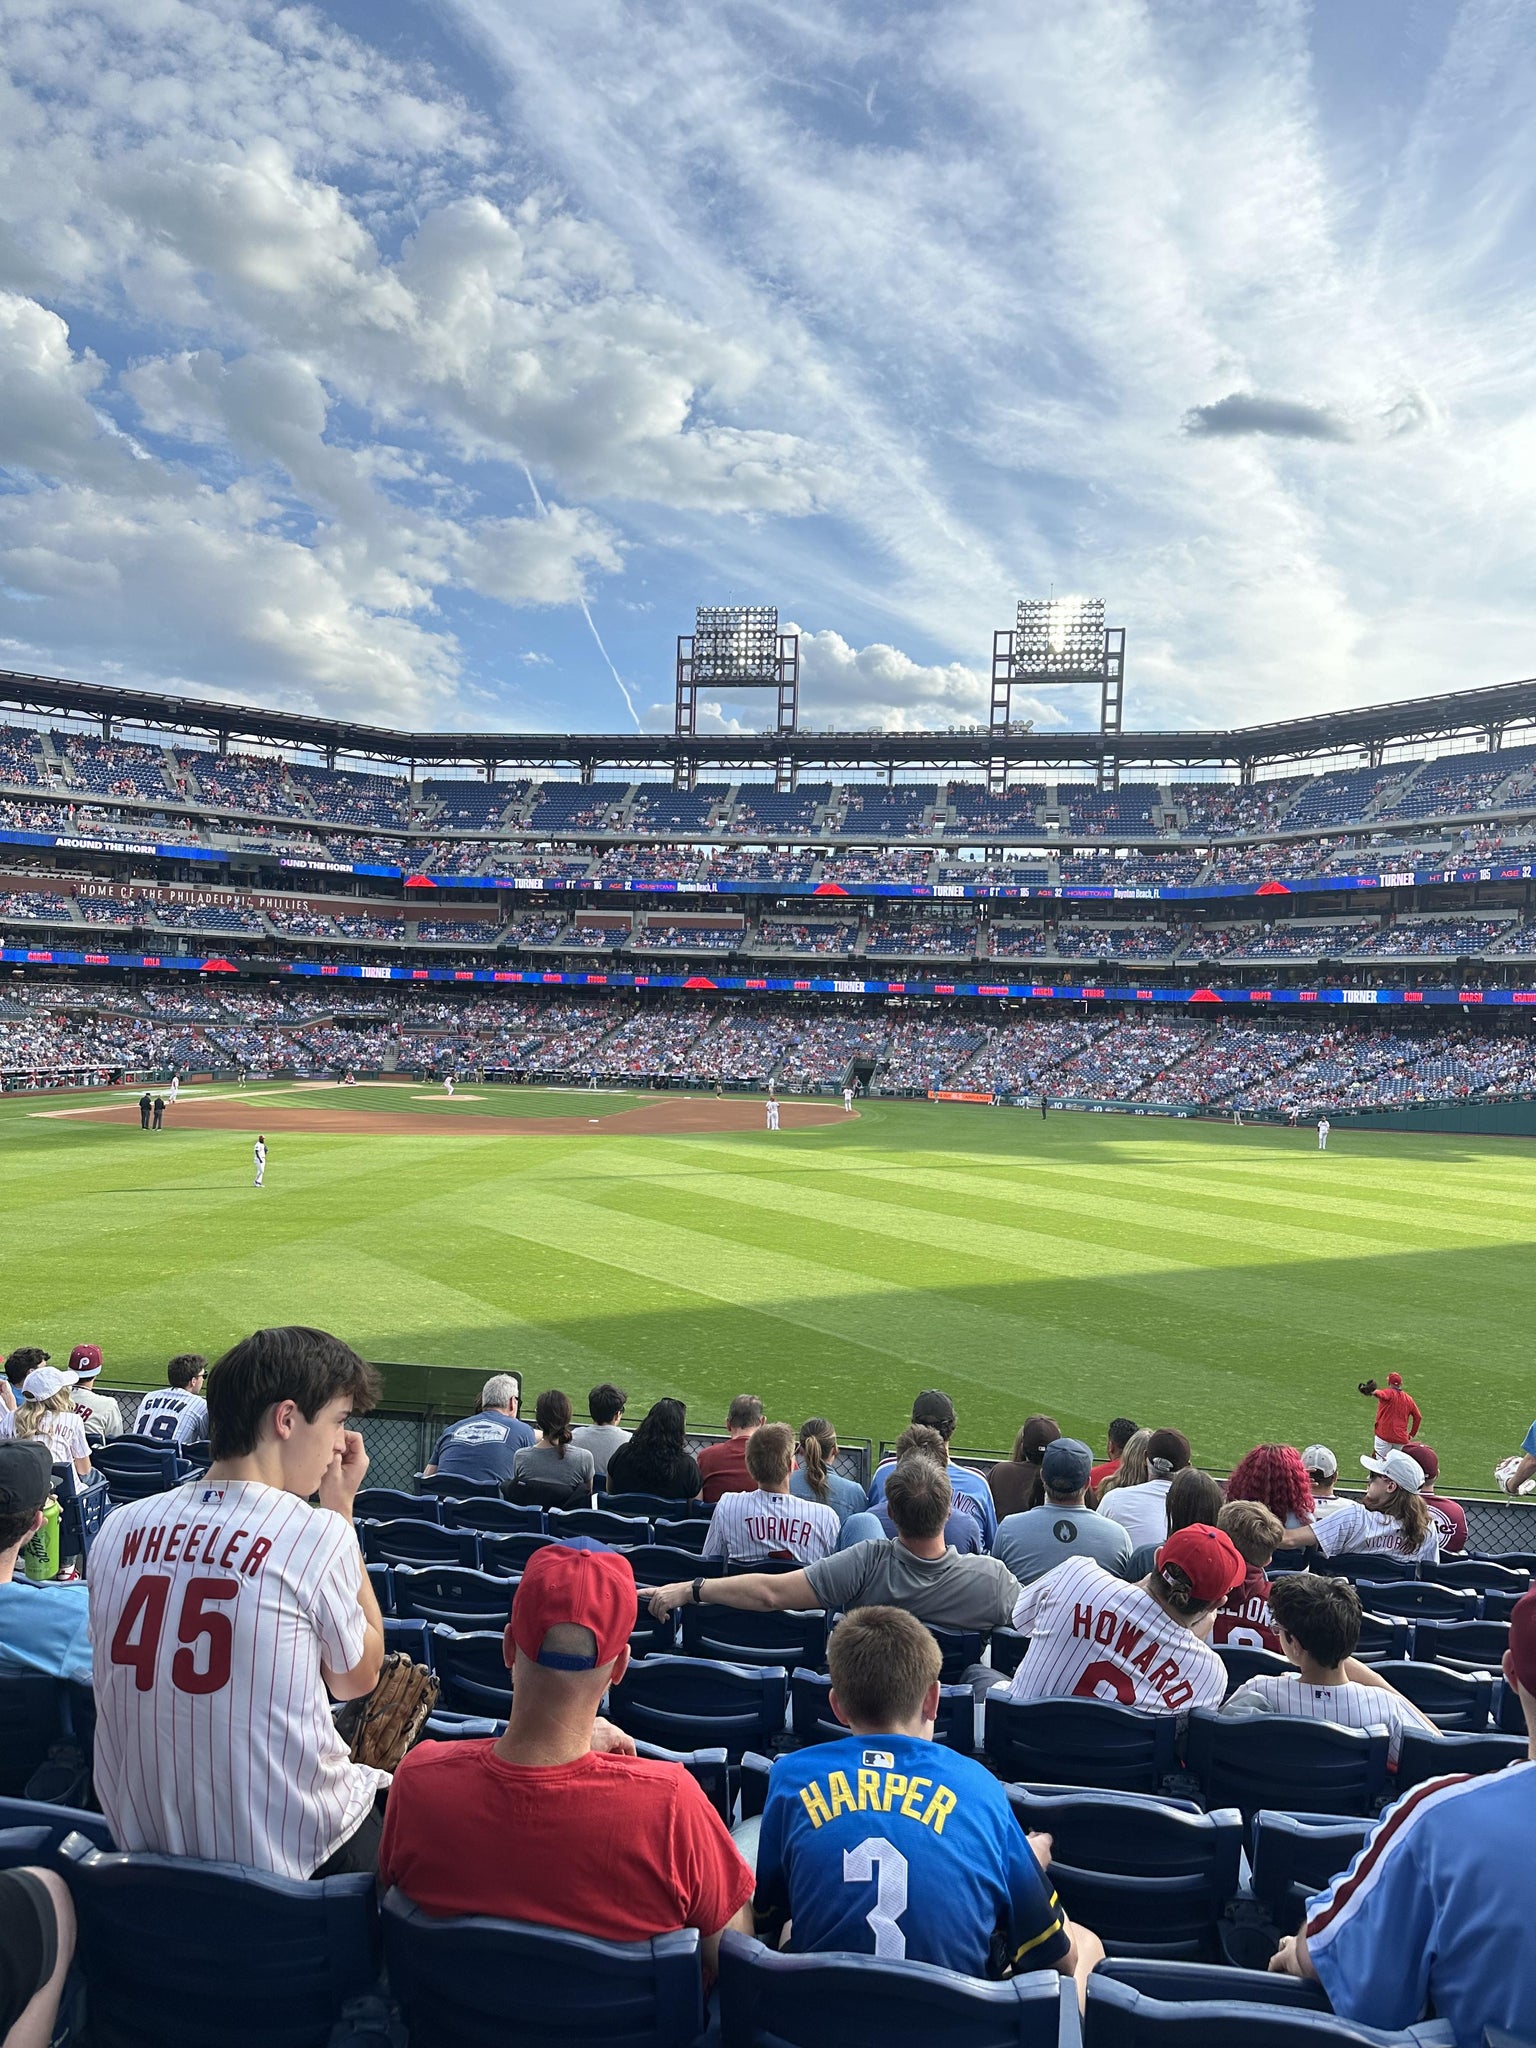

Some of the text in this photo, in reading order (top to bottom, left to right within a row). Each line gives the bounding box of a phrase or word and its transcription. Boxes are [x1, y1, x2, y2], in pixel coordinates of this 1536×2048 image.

[55, 838, 156, 854] AROUND THE HORN
[280, 859, 353, 872] OUND THE HORN
[514, 879, 543, 889] TURNER
[625, 881, 632, 890] 32
[1380, 873, 1415, 887] TURNER
[1479, 869, 1491, 880] 185
[1522, 866, 1531, 877] 32
[80, 884, 114, 897] HOME
[142, 888, 163, 899] THE
[259, 897, 309, 910] PHILLIES
[933, 886, 964, 897] TURNER
[1055, 888, 1062, 897] 32
[1154, 890, 1160, 898] FL
[361, 966, 391, 978] TURNER
[834, 981, 865, 992] TURNER
[1299, 992, 1318, 1001] STOTT
[1342, 990, 1377, 1003] TURNER
[1458, 992, 1483, 1003] MARSH
[144, 1397, 188, 1413] GWYNN
[745, 1516, 812, 1547] TURNER
[121, 1524, 272, 1578] WHEELER
[111, 1574, 239, 1695] 45
[1073, 1603, 1193, 1709] HOWARD
[799, 1768, 958, 1835] HARPER
[843, 1837, 909, 1960] 3
